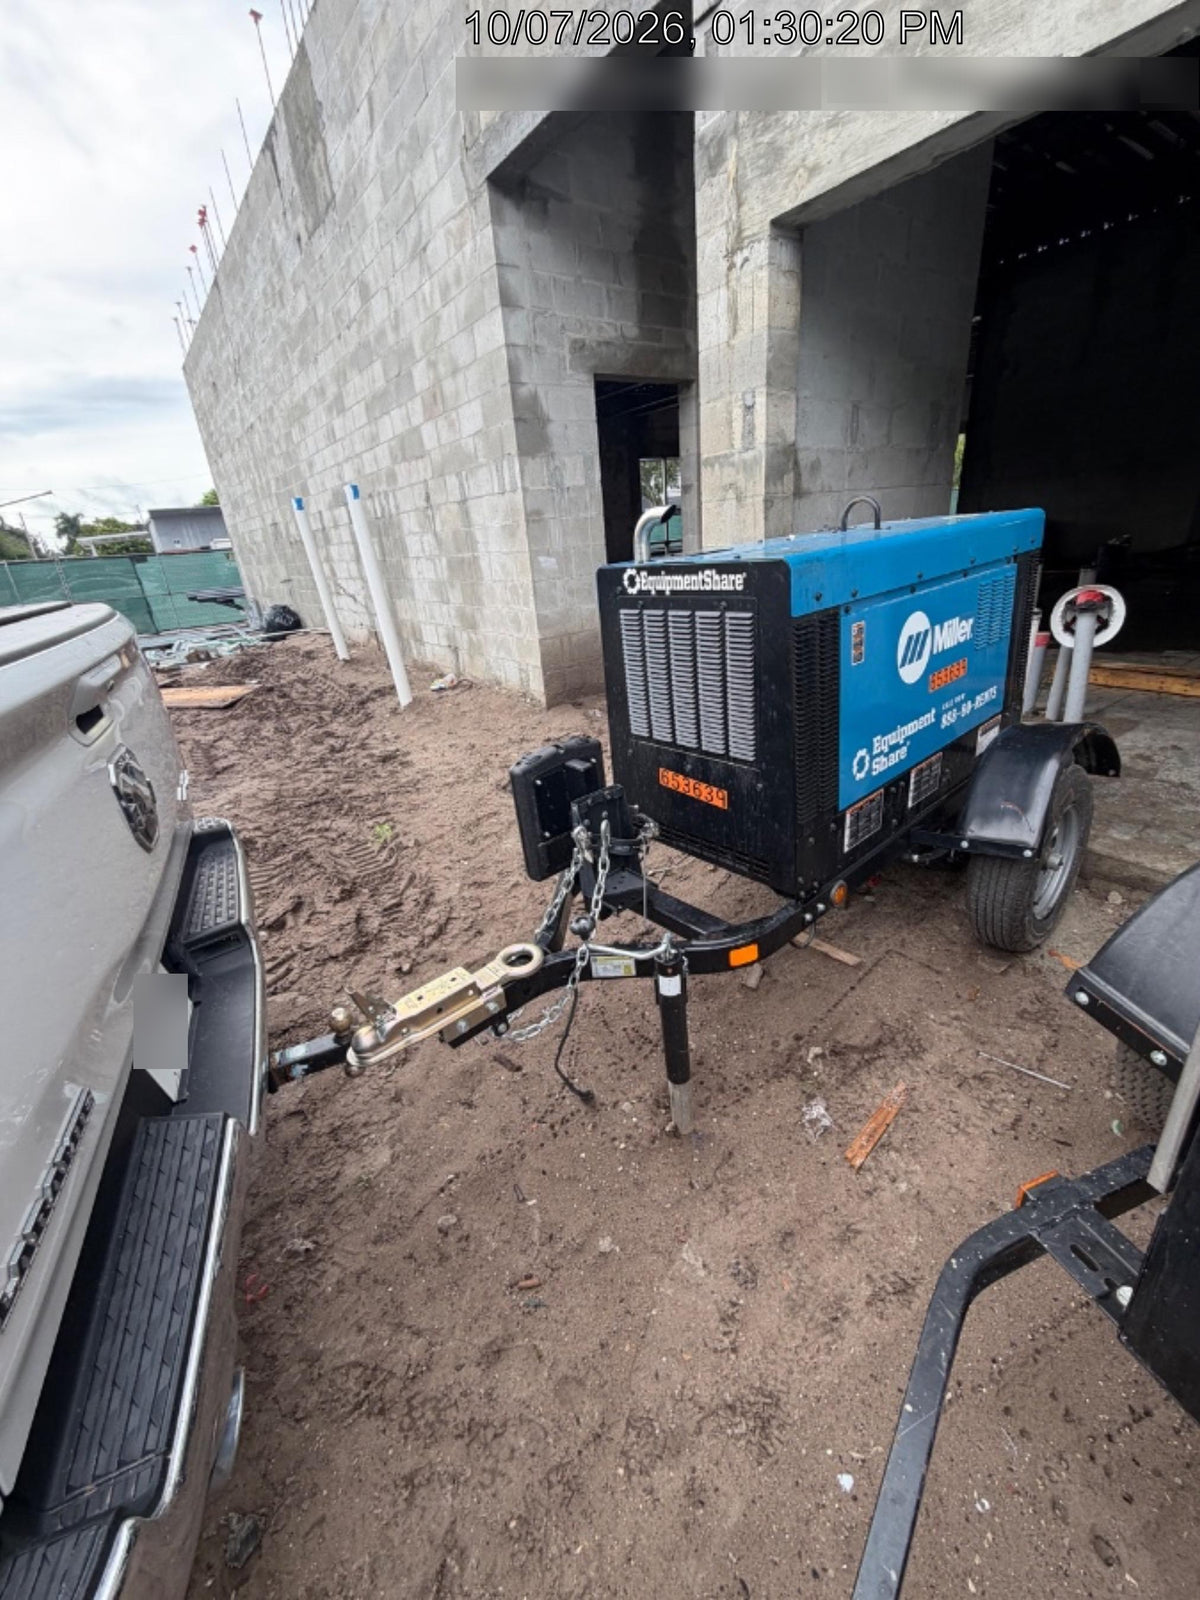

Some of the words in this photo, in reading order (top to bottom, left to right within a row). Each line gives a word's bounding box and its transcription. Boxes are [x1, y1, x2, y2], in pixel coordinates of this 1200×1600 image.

[640, 569, 745, 596] EquipmentShare
[933, 616, 973, 655] Miller
[873, 707, 936, 757] Equipment
[872, 745, 908, 776] Share
[660, 768, 727, 809] 653639
